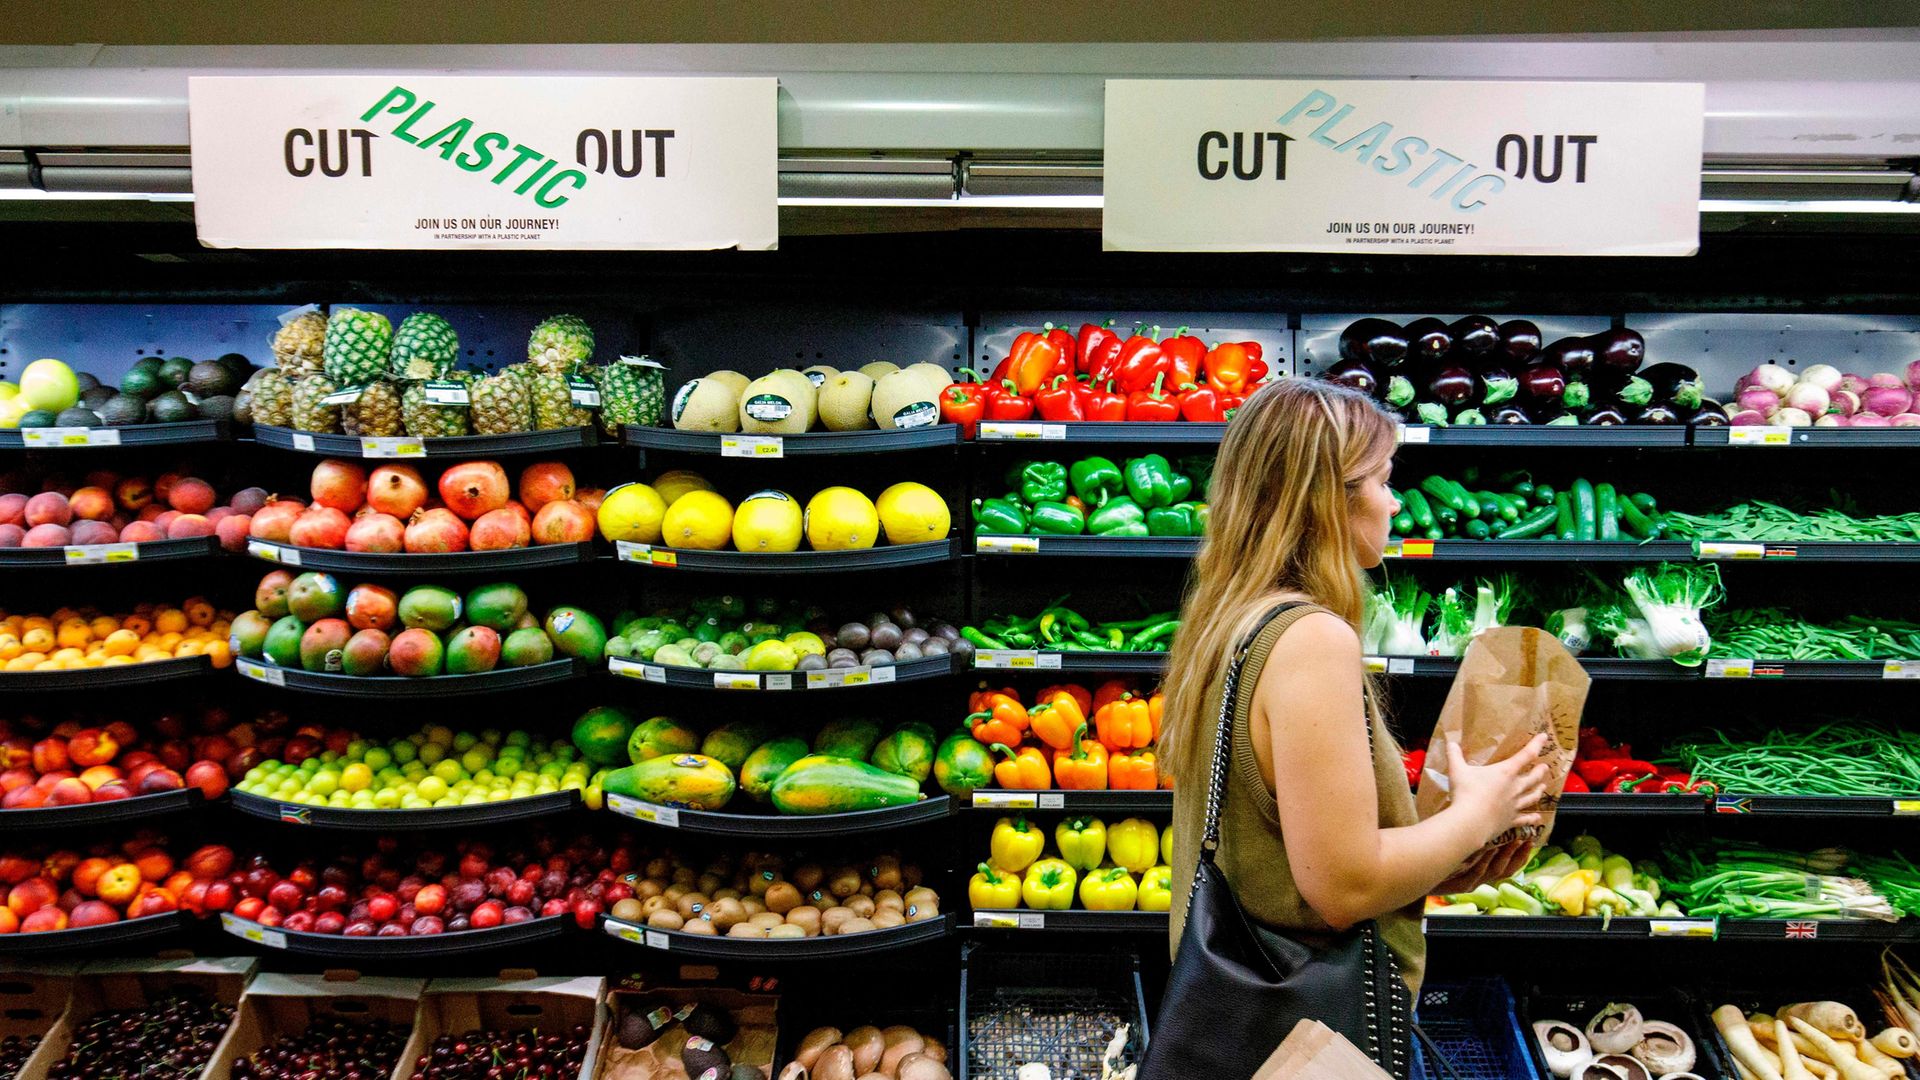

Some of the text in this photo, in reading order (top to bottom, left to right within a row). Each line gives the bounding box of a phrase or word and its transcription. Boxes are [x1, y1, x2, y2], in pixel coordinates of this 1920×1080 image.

[284, 127, 379, 178] CUT
[360, 85, 587, 209] PLASTIC
[576, 128, 674, 179] OUT
[1197, 130, 1297, 181] CUT
[1277, 89, 1506, 213] PLASTIC
[1496, 133, 1597, 183] OUT
[415, 218, 559, 230] JOIN US ON OUR JOURNEY!
[1326, 222, 1475, 234] JOIN US ON OUR JOURNEY!
